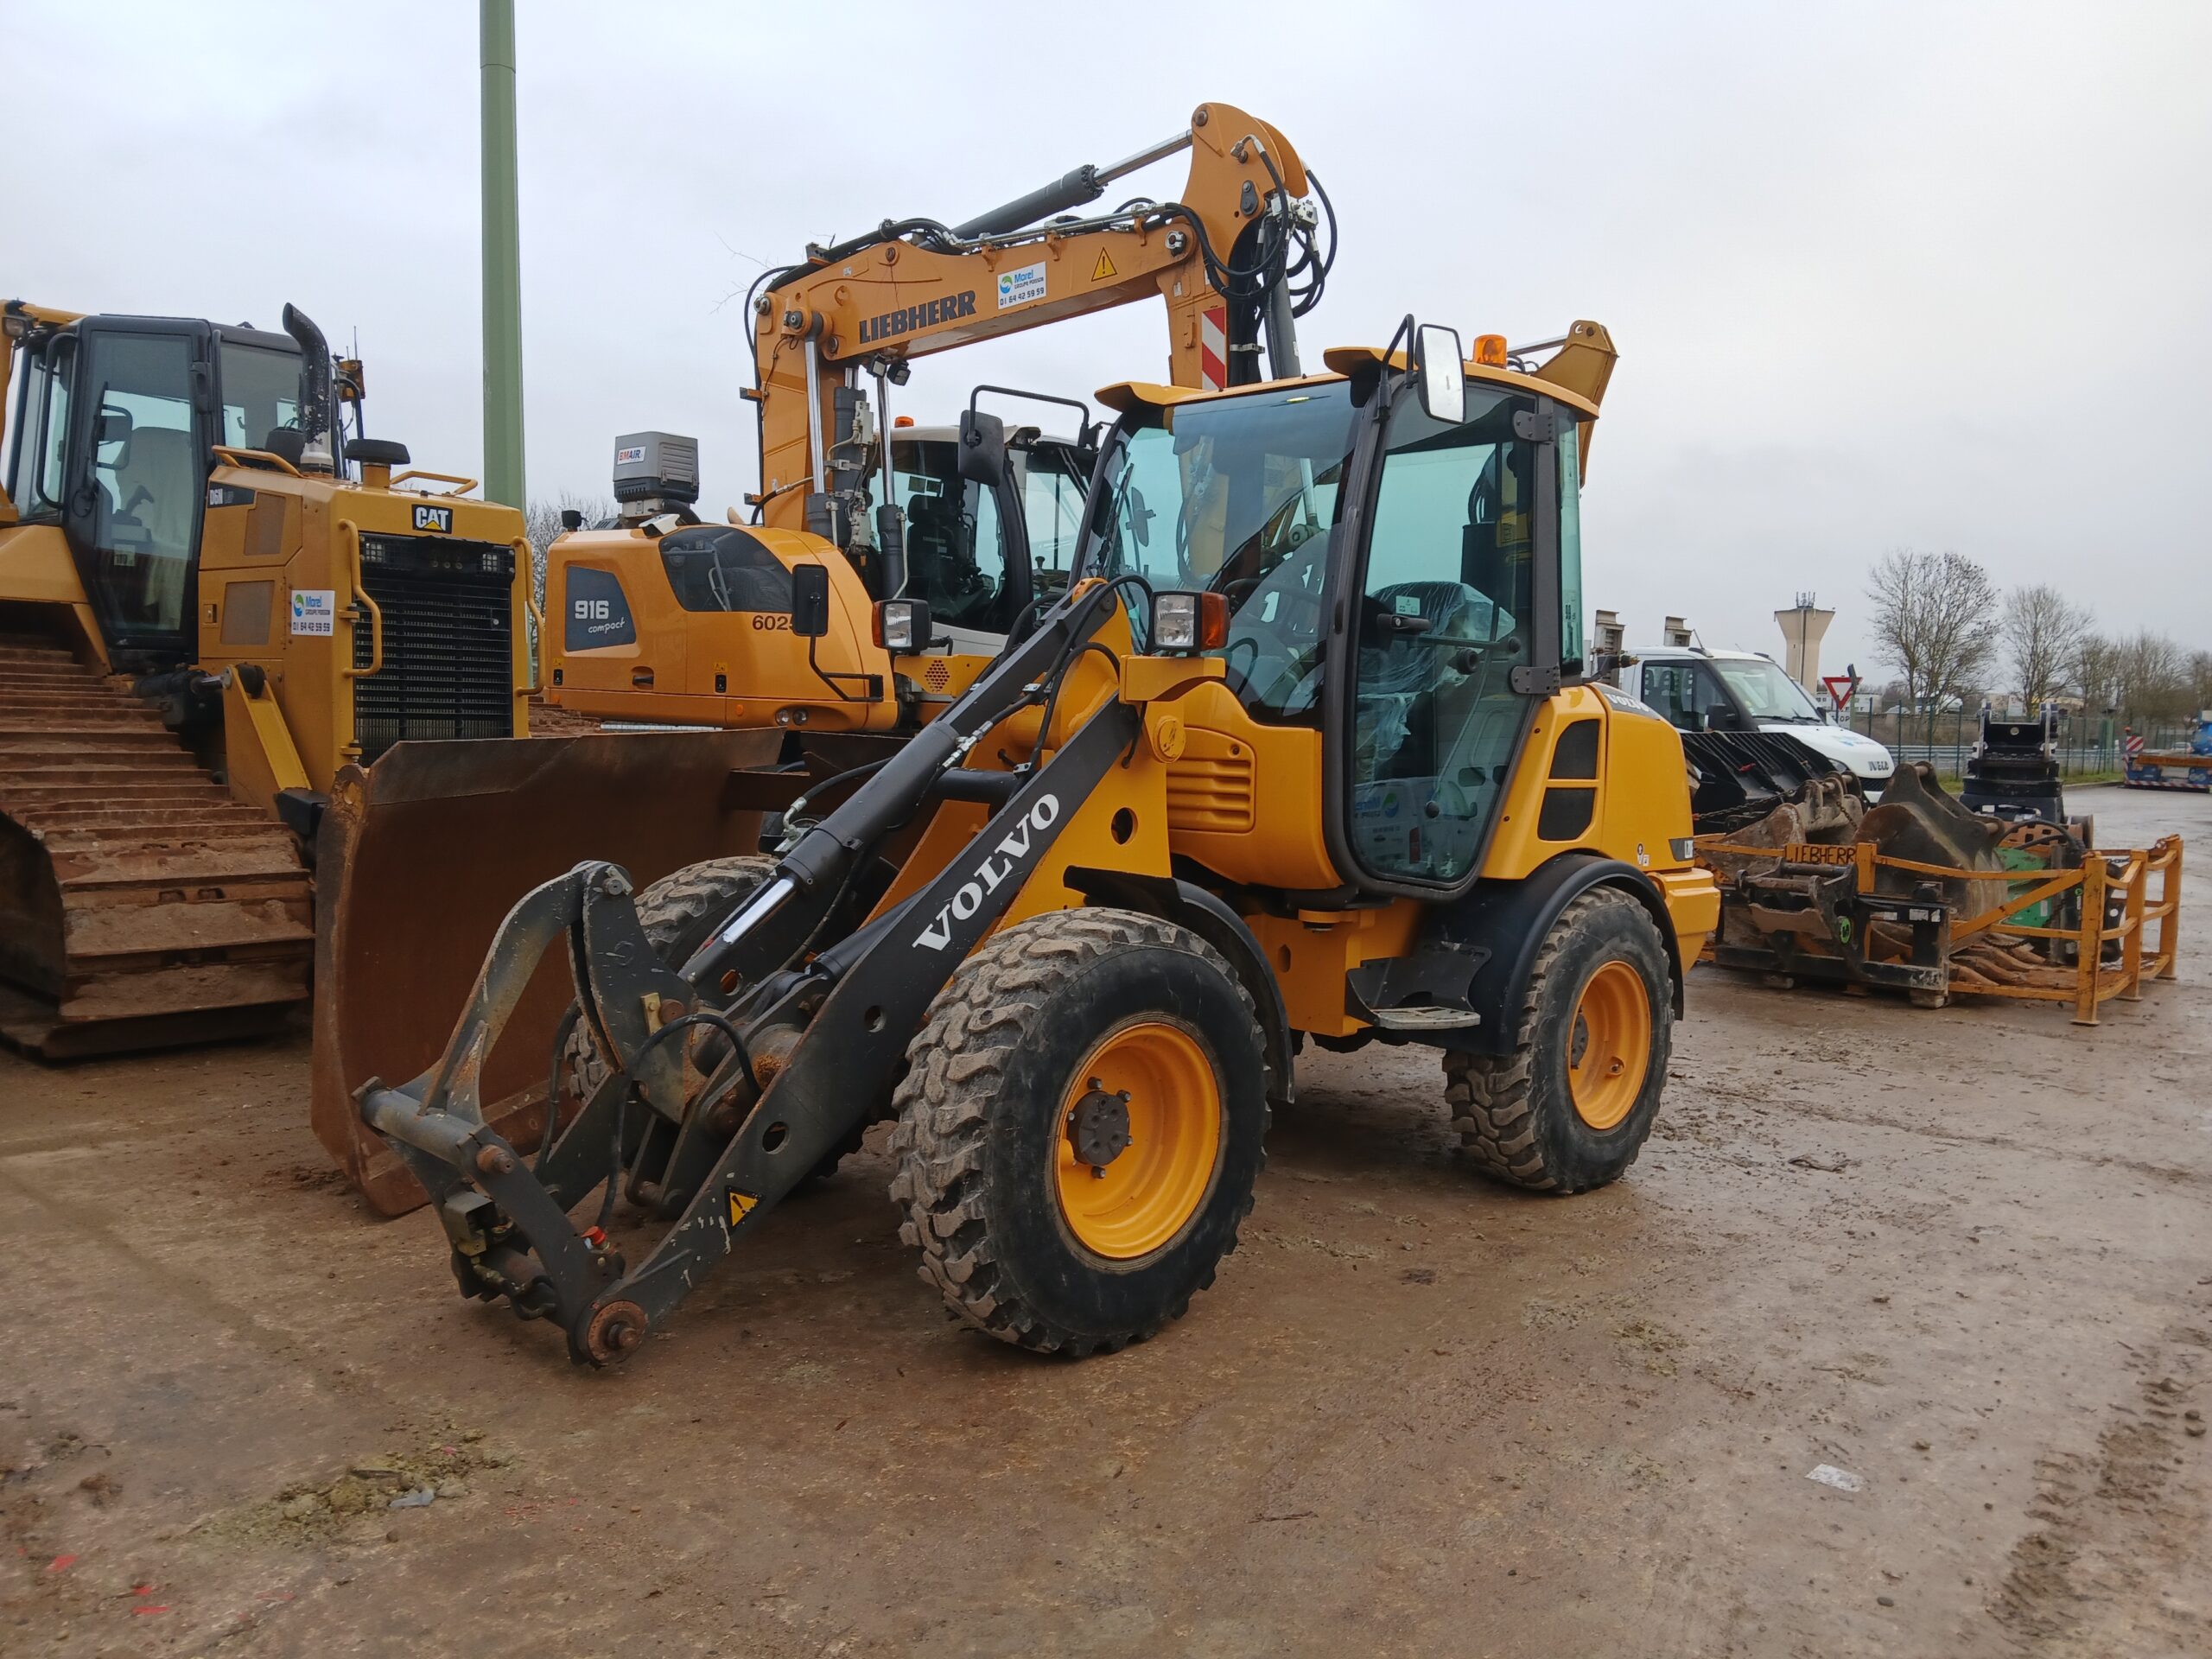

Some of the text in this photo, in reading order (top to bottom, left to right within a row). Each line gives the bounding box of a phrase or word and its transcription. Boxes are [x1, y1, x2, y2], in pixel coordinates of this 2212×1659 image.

[1014, 270, 1033, 283] Morel
[1000, 287, 1045, 306] 01 64 42 59 59
[860, 290, 976, 344] LIEBHERR
[416, 506, 448, 531] CAT
[575, 600, 608, 620] 916
[588, 616, 626, 634] compact
[1785, 846, 1856, 865] LIEBHERR
[912, 794, 1059, 951] VOLVO
